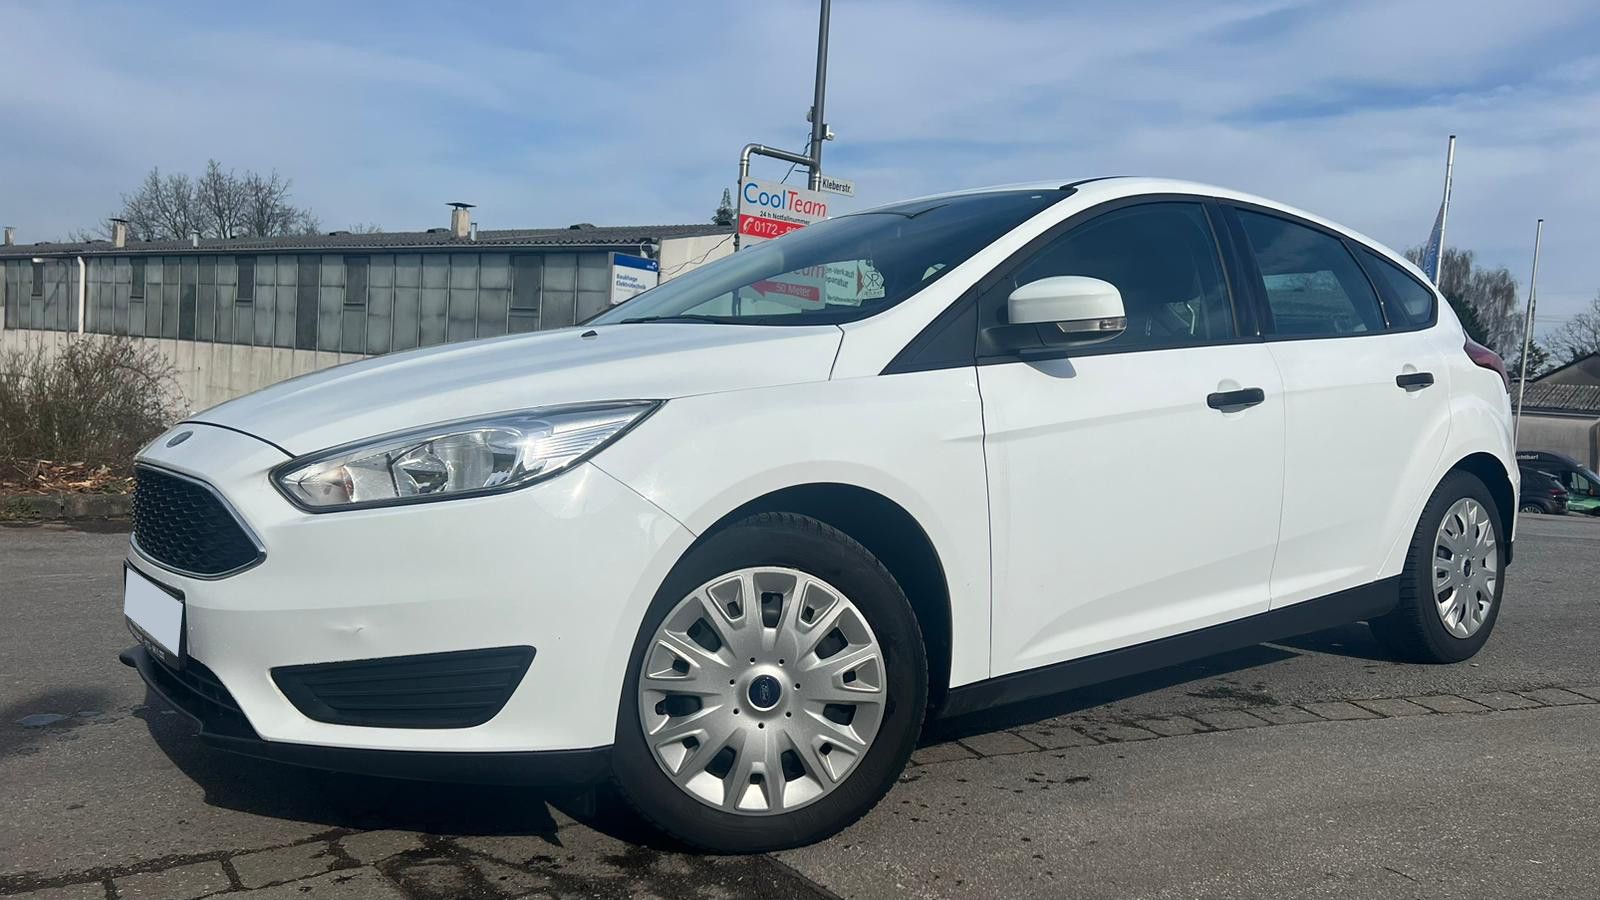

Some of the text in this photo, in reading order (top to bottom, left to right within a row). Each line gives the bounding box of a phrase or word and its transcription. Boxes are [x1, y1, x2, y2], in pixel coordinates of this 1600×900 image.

[822, 178, 852, 193] Kleberstr.
[772, 213, 811, 224] Notfallnummer
[754, 222, 778, 235] 0172
[788, 285, 812, 297] Meter
